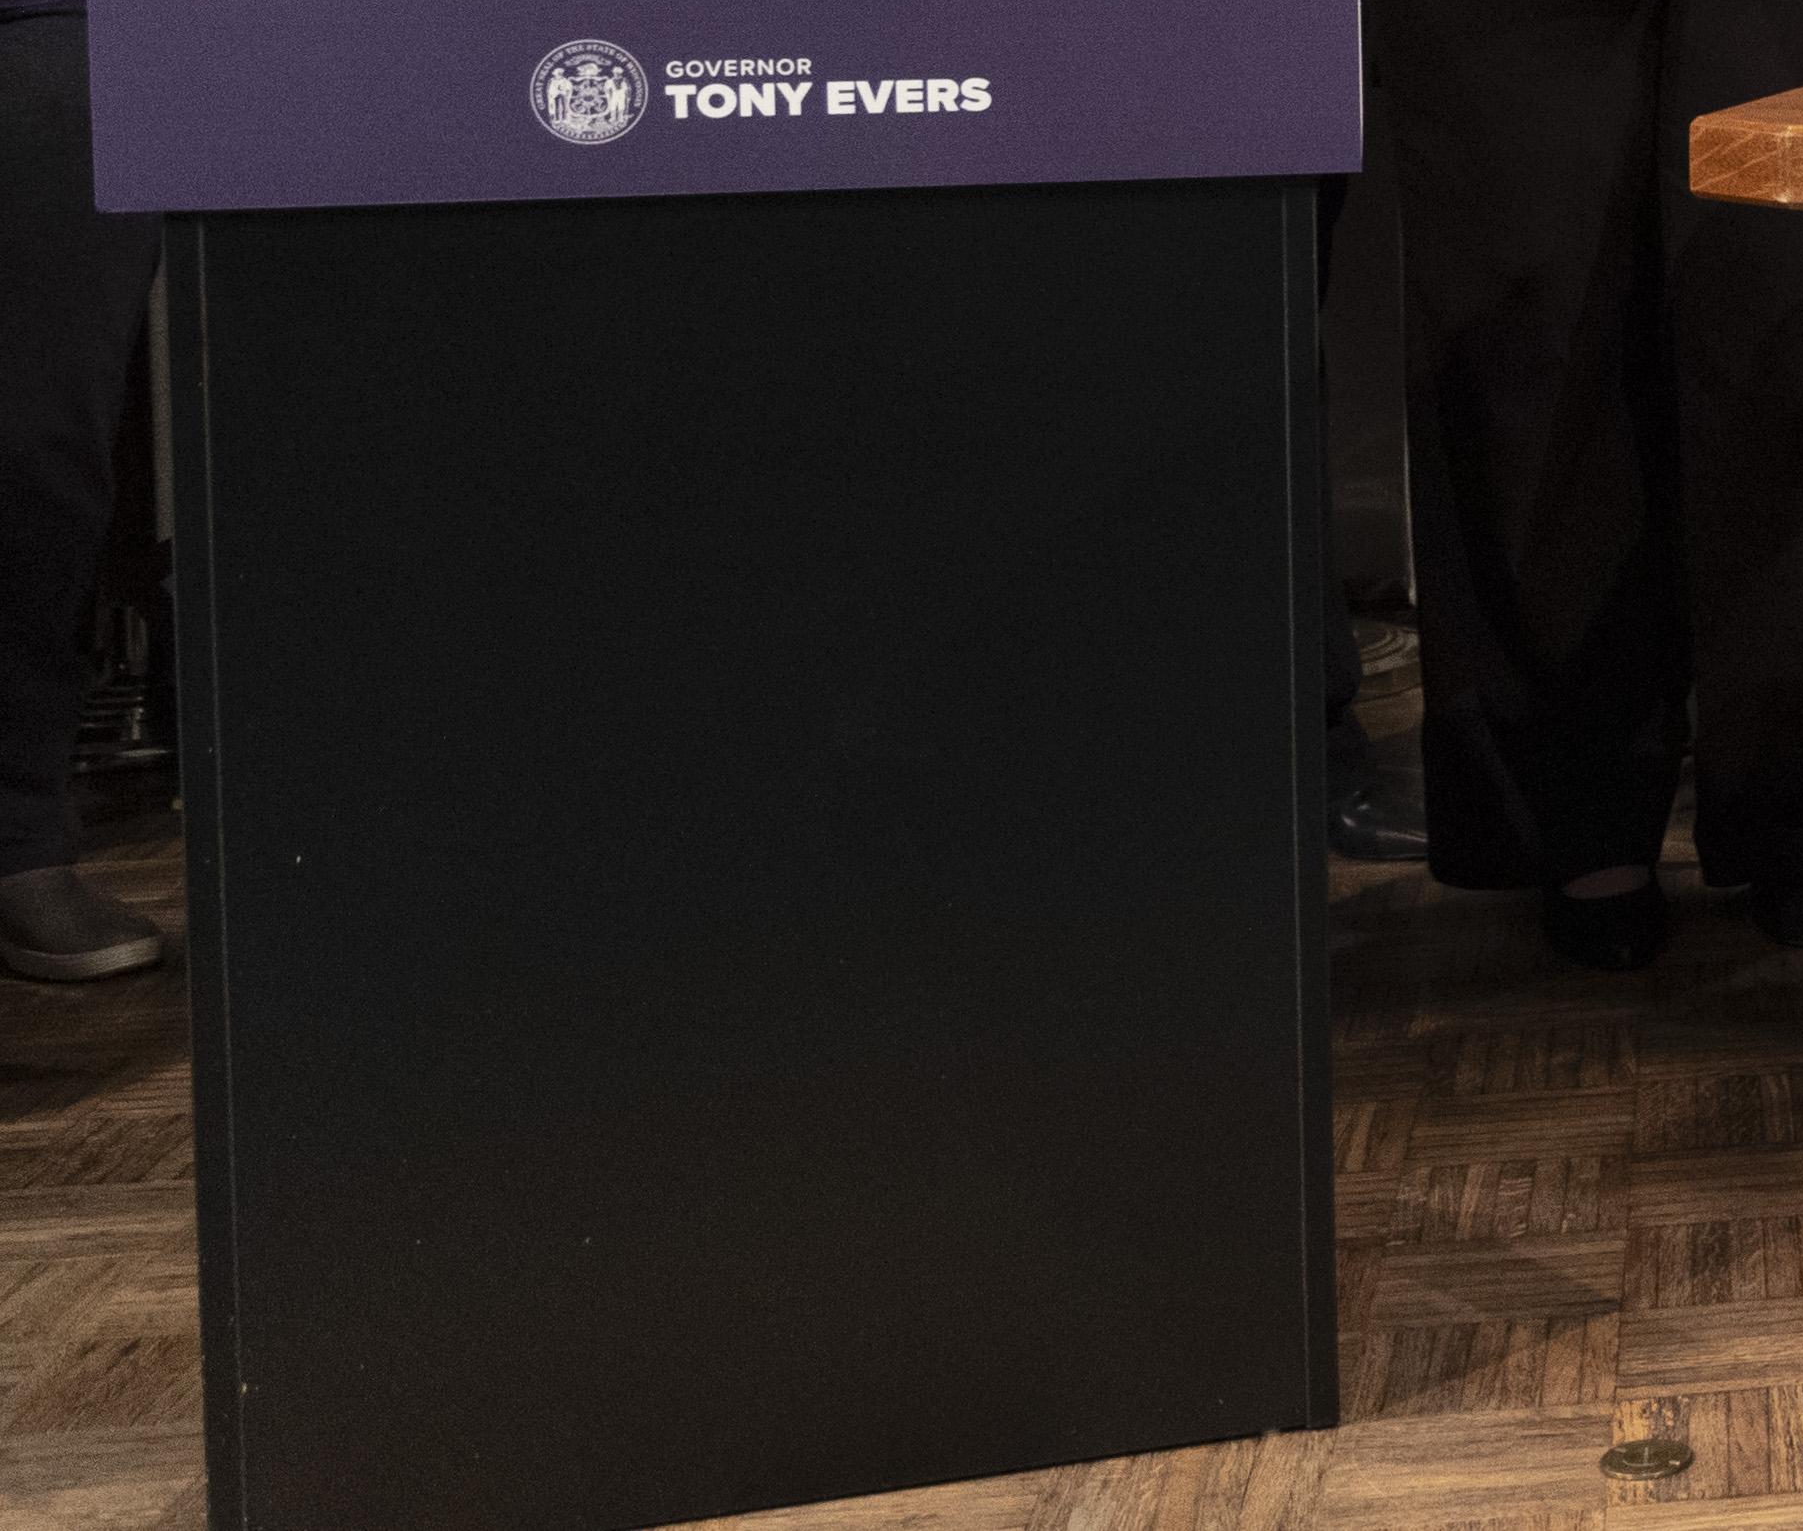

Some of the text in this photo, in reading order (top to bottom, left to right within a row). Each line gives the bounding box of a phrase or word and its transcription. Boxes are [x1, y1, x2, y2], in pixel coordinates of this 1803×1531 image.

[666, 58, 811, 78] GOVERNOR
[665, 78, 991, 118] TONY EVERS
